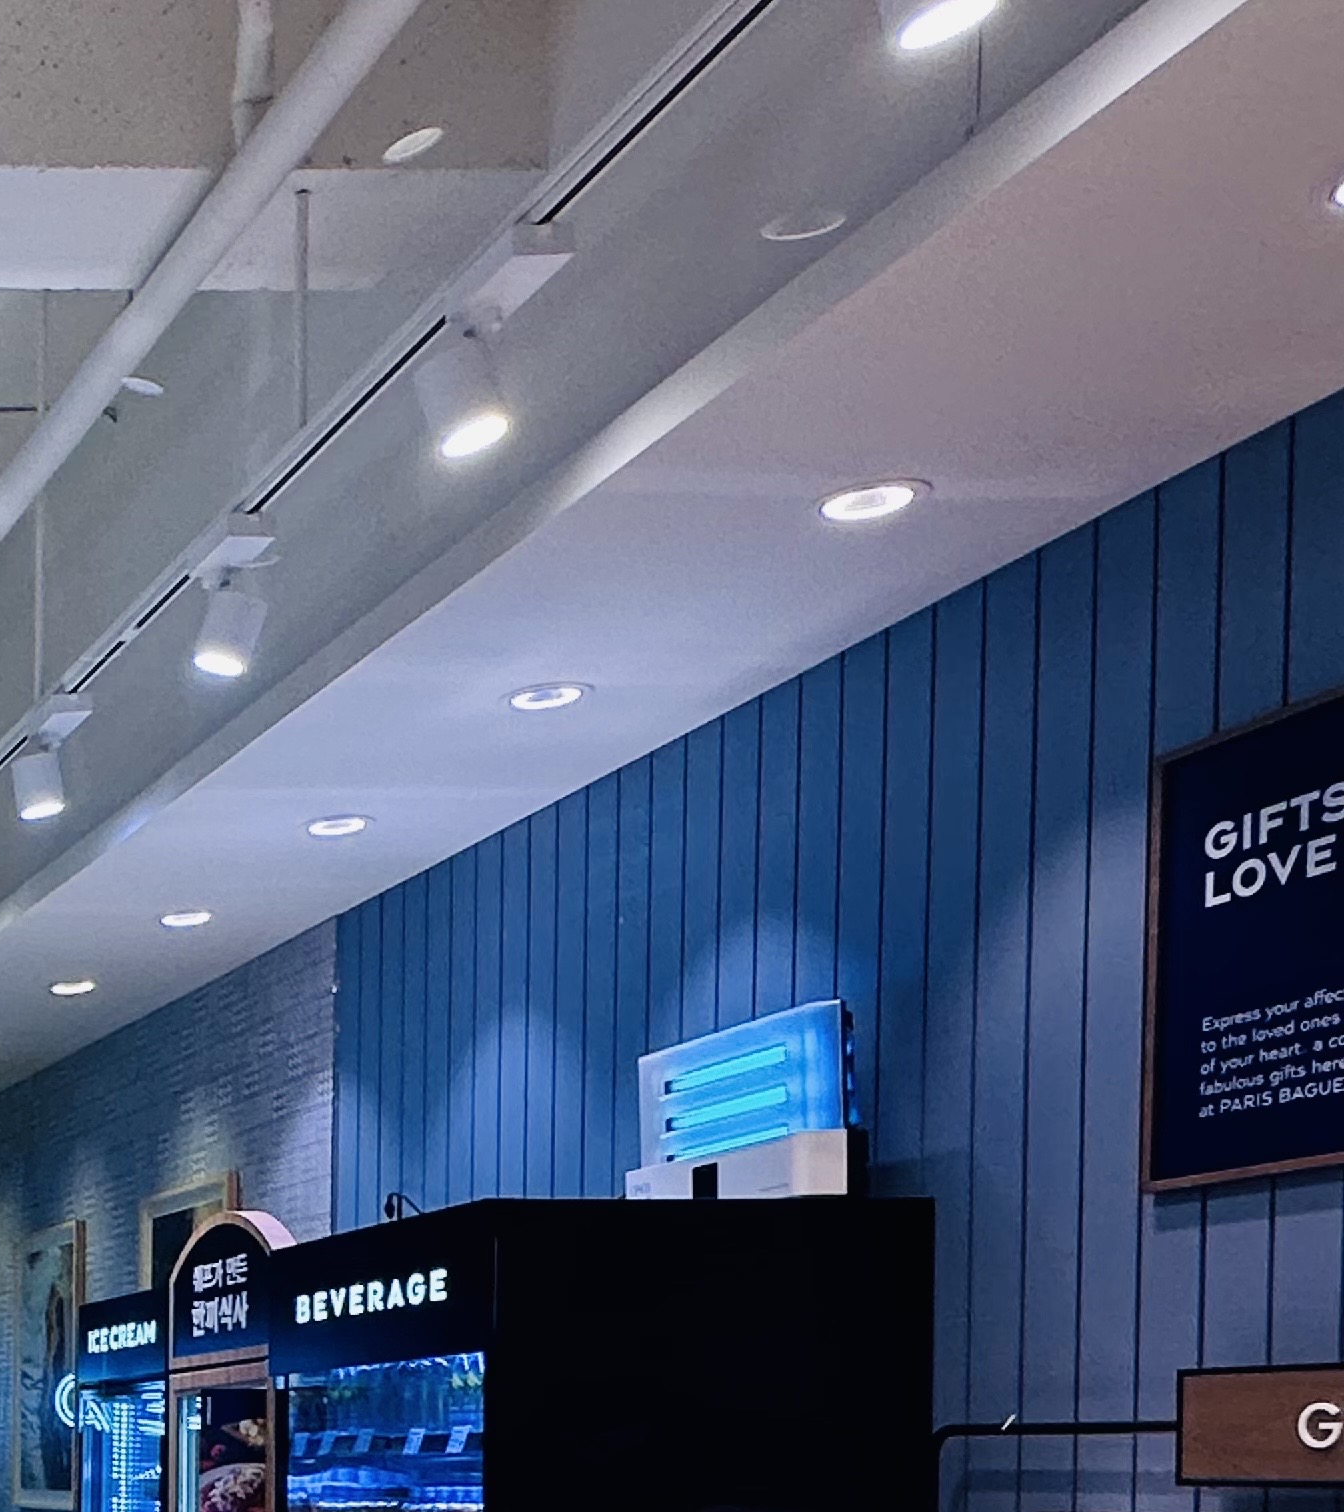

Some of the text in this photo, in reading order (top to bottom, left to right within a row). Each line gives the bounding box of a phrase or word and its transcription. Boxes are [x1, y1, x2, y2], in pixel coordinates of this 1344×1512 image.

[1205, 781, 1344, 860] GIFTS
[1204, 834, 1337, 908] LOVE
[1200, 1013, 1341, 1054] to the loved ones
[1202, 1008, 1261, 1032] Express
[1265, 1000, 1300, 1022] your
[1200, 1057, 1216, 1075] of
[1220, 1054, 1255, 1074] your
[1313, 1040, 1323, 1051] a
[1199, 1074, 1264, 1096] fabulous
[1269, 1064, 1307, 1087] gifts
[1198, 1104, 1215, 1118] at
[1220, 1091, 1273, 1113] PARIS
[295, 1268, 449, 1325] BEVERAGE
[87, 1319, 157, 1354] ICE CREAM
[1298, 1402, 1344, 1449] G
